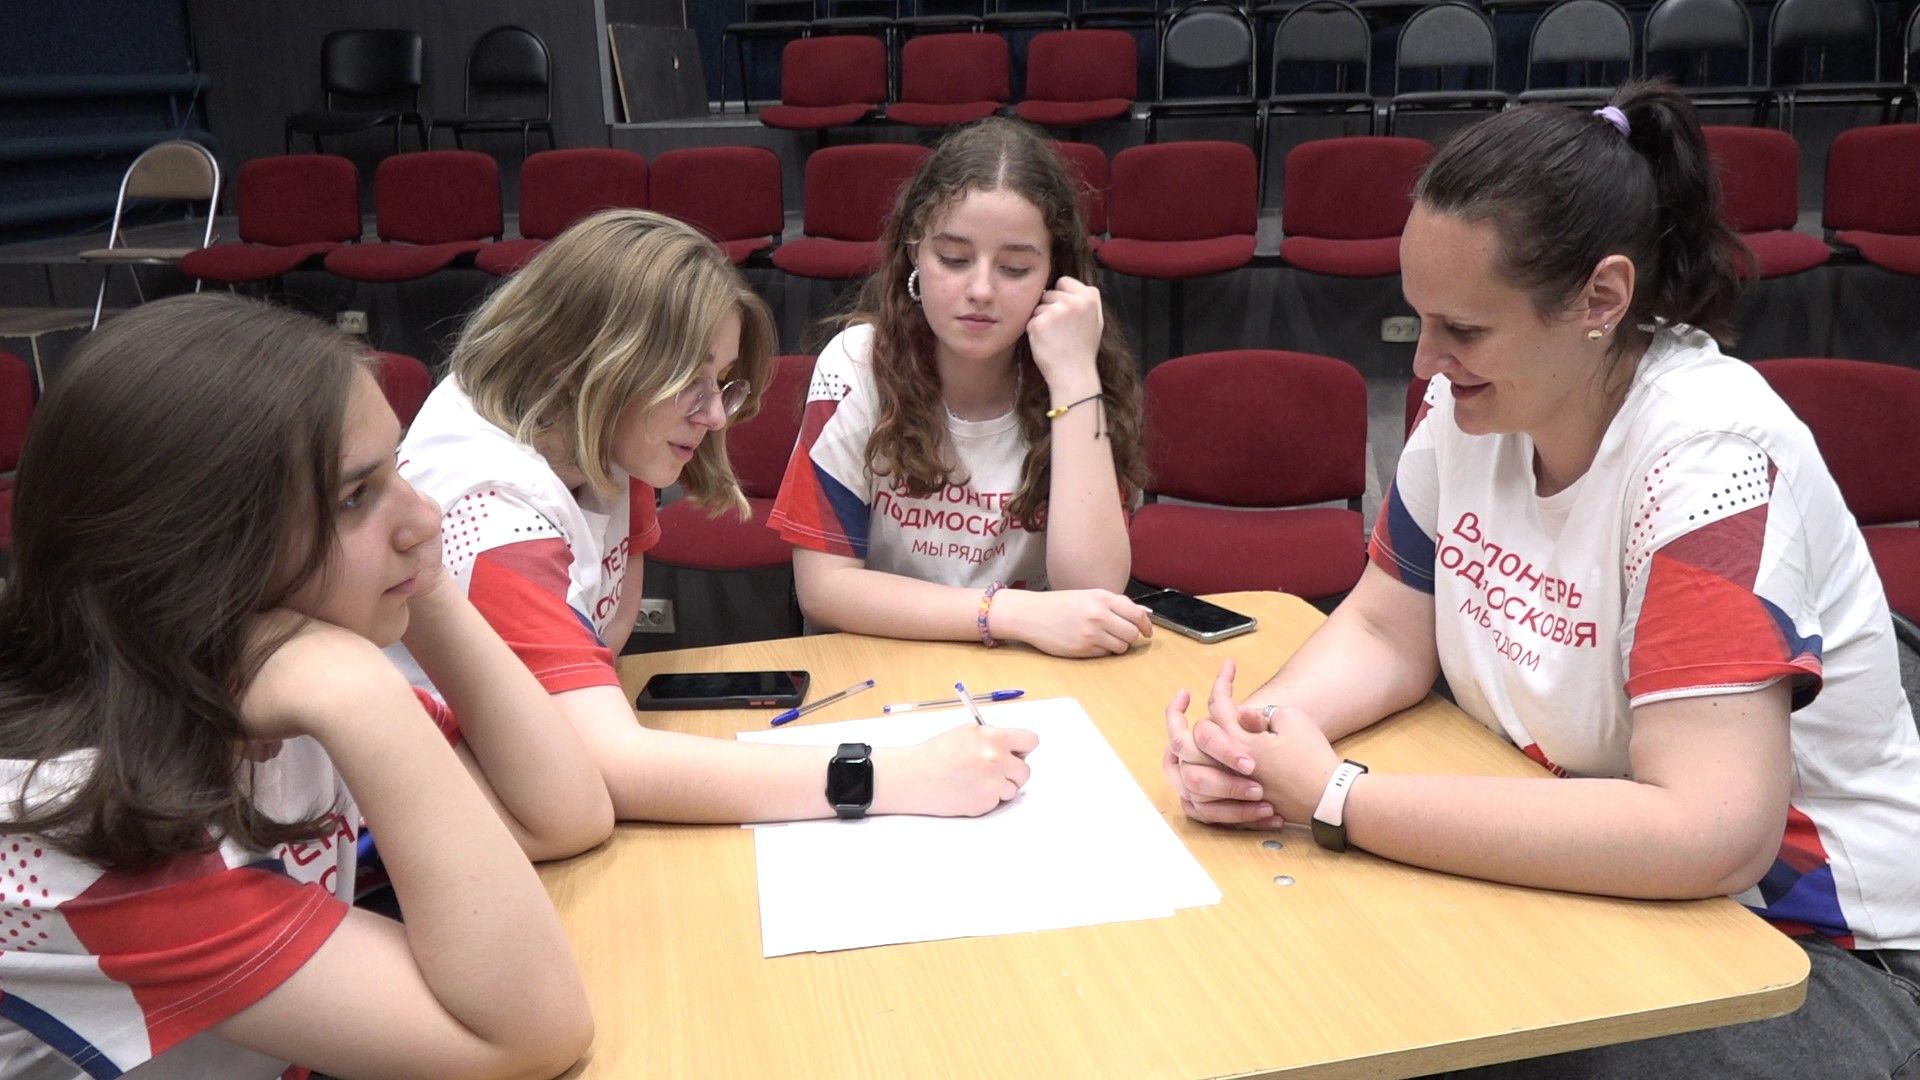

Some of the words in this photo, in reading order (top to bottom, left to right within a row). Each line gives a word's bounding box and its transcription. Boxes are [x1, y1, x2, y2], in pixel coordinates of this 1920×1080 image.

[912, 539, 943, 558] МЫ
[948, 543, 1006, 566] РЯДОМ
[1493, 629, 1541, 672] ЯДОМ
